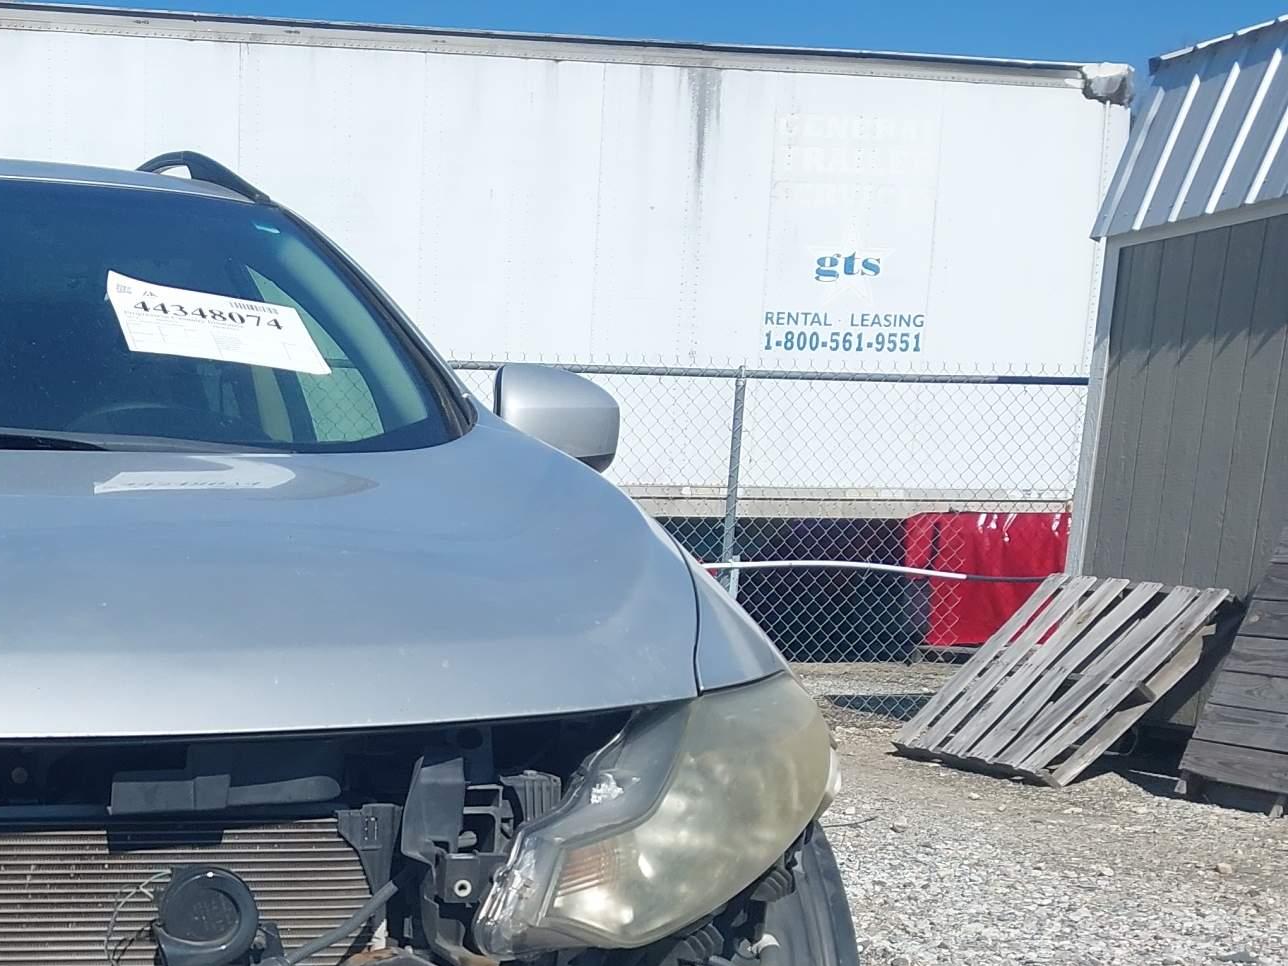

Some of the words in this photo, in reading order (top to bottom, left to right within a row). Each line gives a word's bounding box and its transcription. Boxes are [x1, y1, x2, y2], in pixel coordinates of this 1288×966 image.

[814, 251, 881, 283] gts
[133, 299, 284, 331] 44348074
[764, 311, 833, 327] RENTAL
[850, 313, 924, 328] LEASING
[764, 330, 922, 353] 1-800-561-9551
